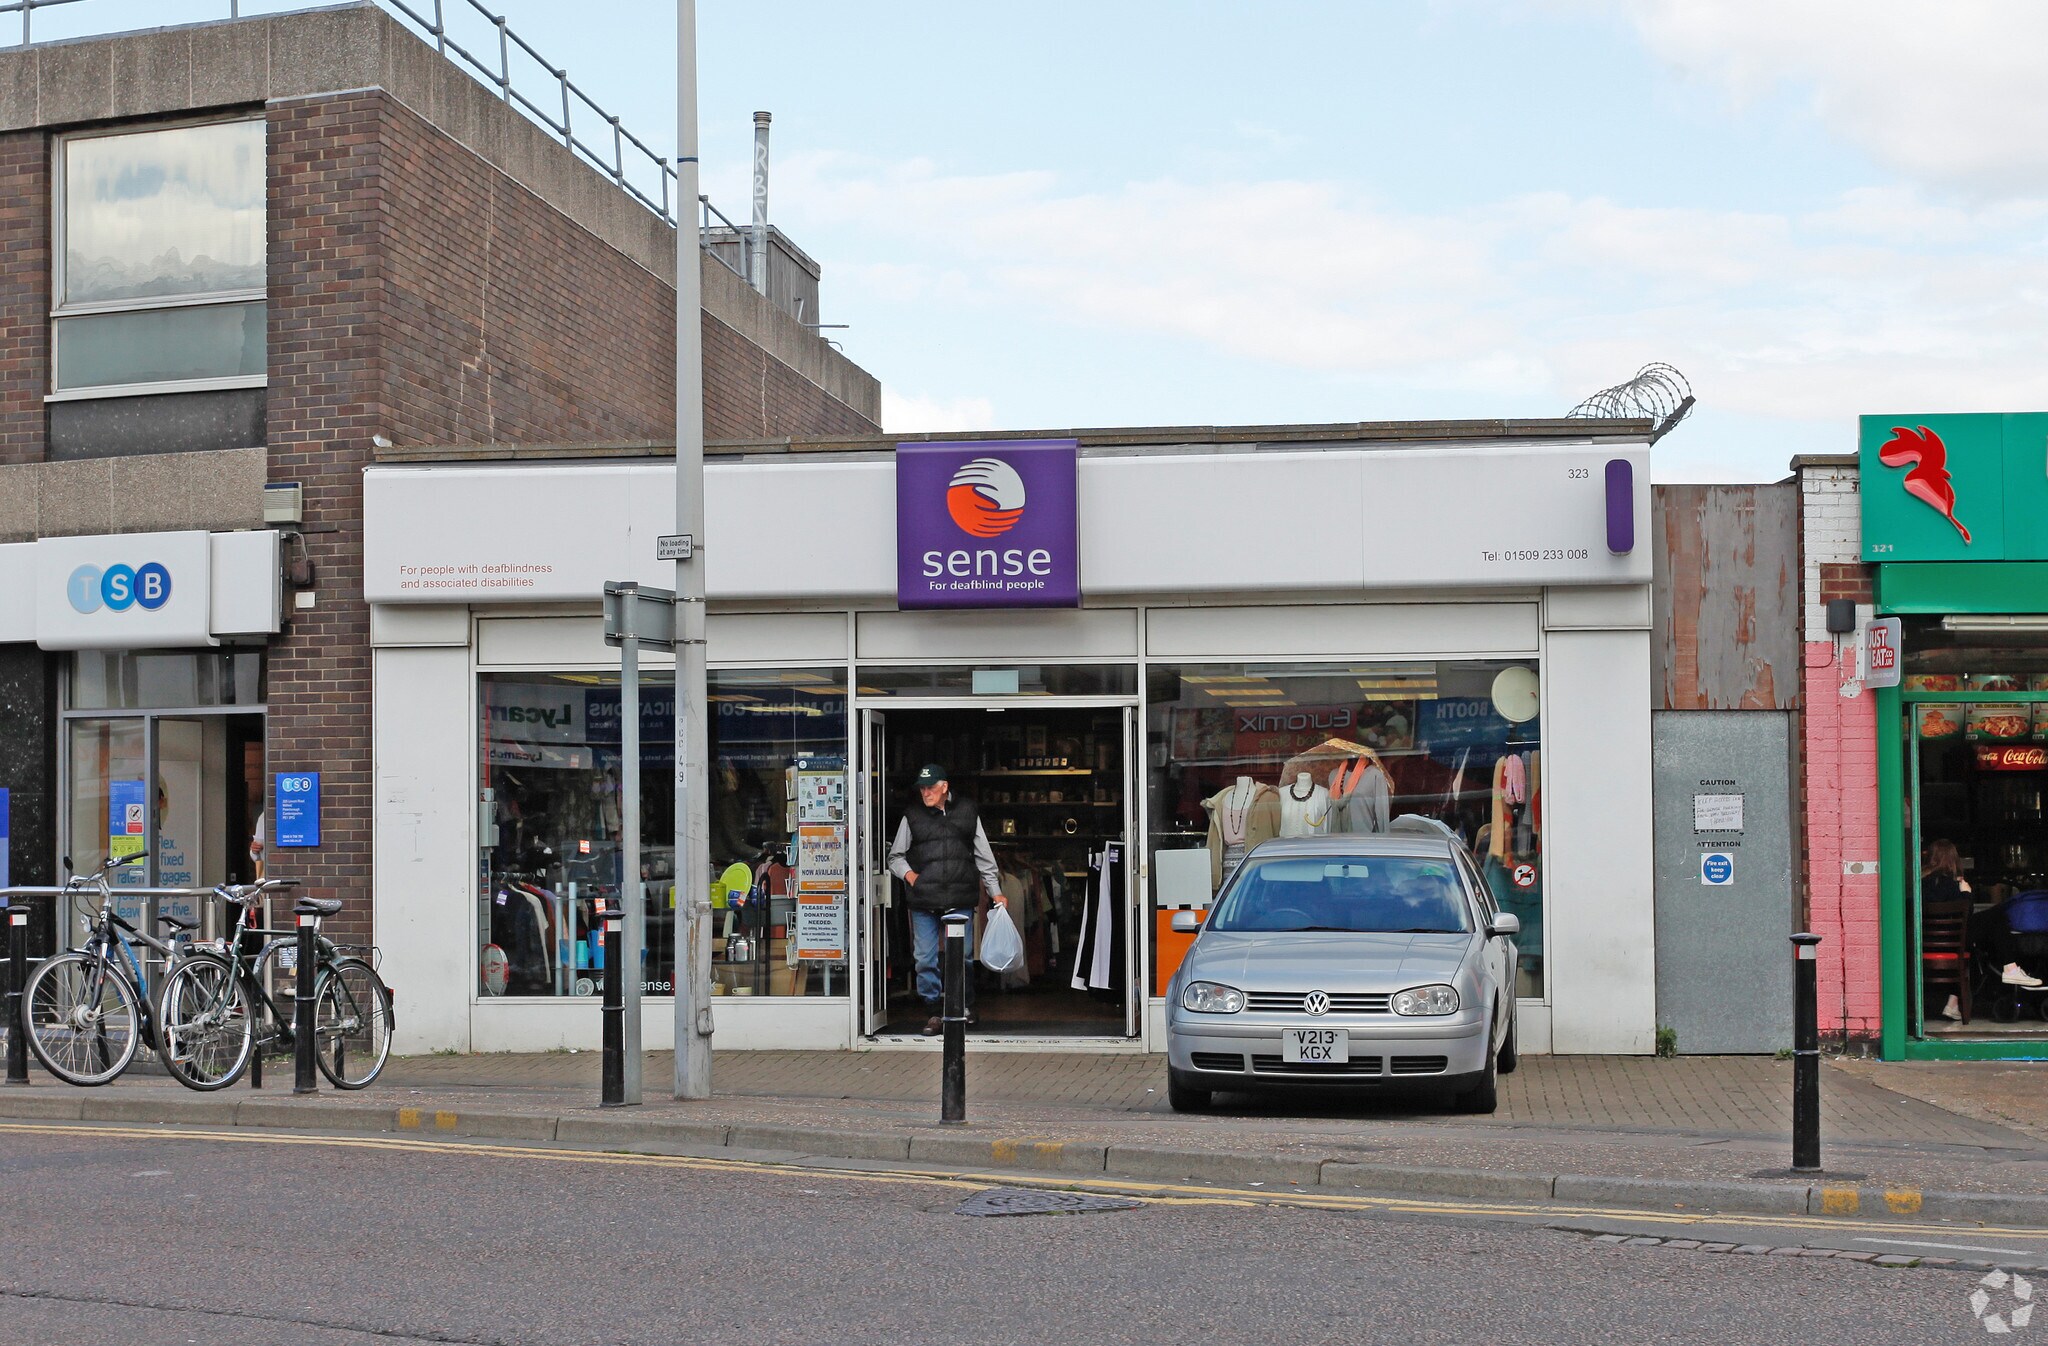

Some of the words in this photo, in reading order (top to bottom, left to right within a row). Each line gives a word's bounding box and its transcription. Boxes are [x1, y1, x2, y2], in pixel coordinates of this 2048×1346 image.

[1567, 468, 1590, 479] 323
[670, 540, 690, 548] loading
[1871, 544, 1894, 553] 321
[922, 548, 1051, 577] sense
[1481, 551, 1501, 562] Tel:
[1504, 550, 1540, 561] 01509
[1542, 550, 1564, 560] 233
[1567, 549, 1589, 560] 008
[400, 565, 418, 575] For
[420, 564, 455, 577] people
[458, 564, 479, 574] with
[481, 563, 553, 574] deafblindness
[77, 571, 165, 604] TSB
[400, 578, 420, 589] and
[422, 578, 478, 588] associated
[480, 576, 534, 588] disabilities
[929, 580, 947, 591] For
[950, 579, 1003, 590] deafblind
[1006, 579, 1045, 591] people
[1868, 628, 1887, 649] JUST
[1871, 648, 1886, 667] EAT
[2003, 748, 2048, 765] Coca-Cola
[285, 780, 310, 790] TSB
[160, 852, 184, 866] fixed
[814, 854, 830, 862] STOCK
[117, 902, 141, 918] leav
[172, 902, 192, 916] five.
[1296, 1030, 1335, 1044] V213
[1300, 1046, 1332, 1060] KGX
